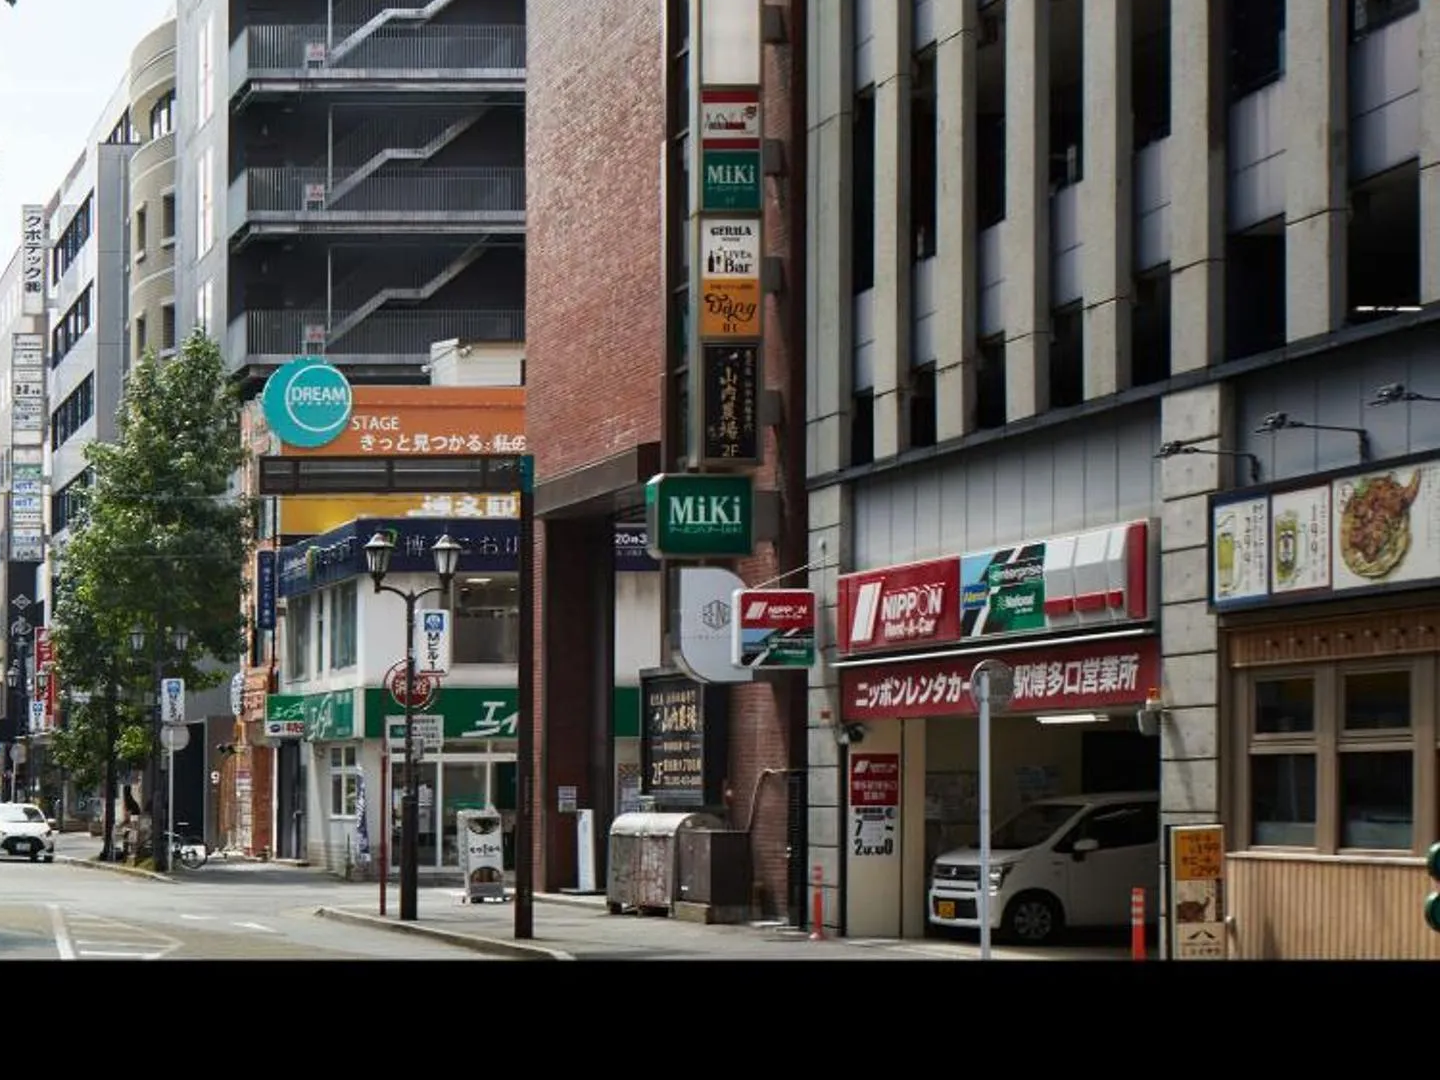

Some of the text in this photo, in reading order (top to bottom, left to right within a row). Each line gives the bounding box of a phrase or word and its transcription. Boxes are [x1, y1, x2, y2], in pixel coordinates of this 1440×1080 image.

[707, 164, 756, 185] MiKi
[724, 258, 752, 273] Bar
[291, 387, 346, 402] DREAM
[351, 416, 400, 431] STAGE
[669, 496, 741, 524] MiKi
[882, 584, 944, 620] NIPPON
[856, 654, 1139, 708] ニッポンレンタカー 駅博多口営業所
